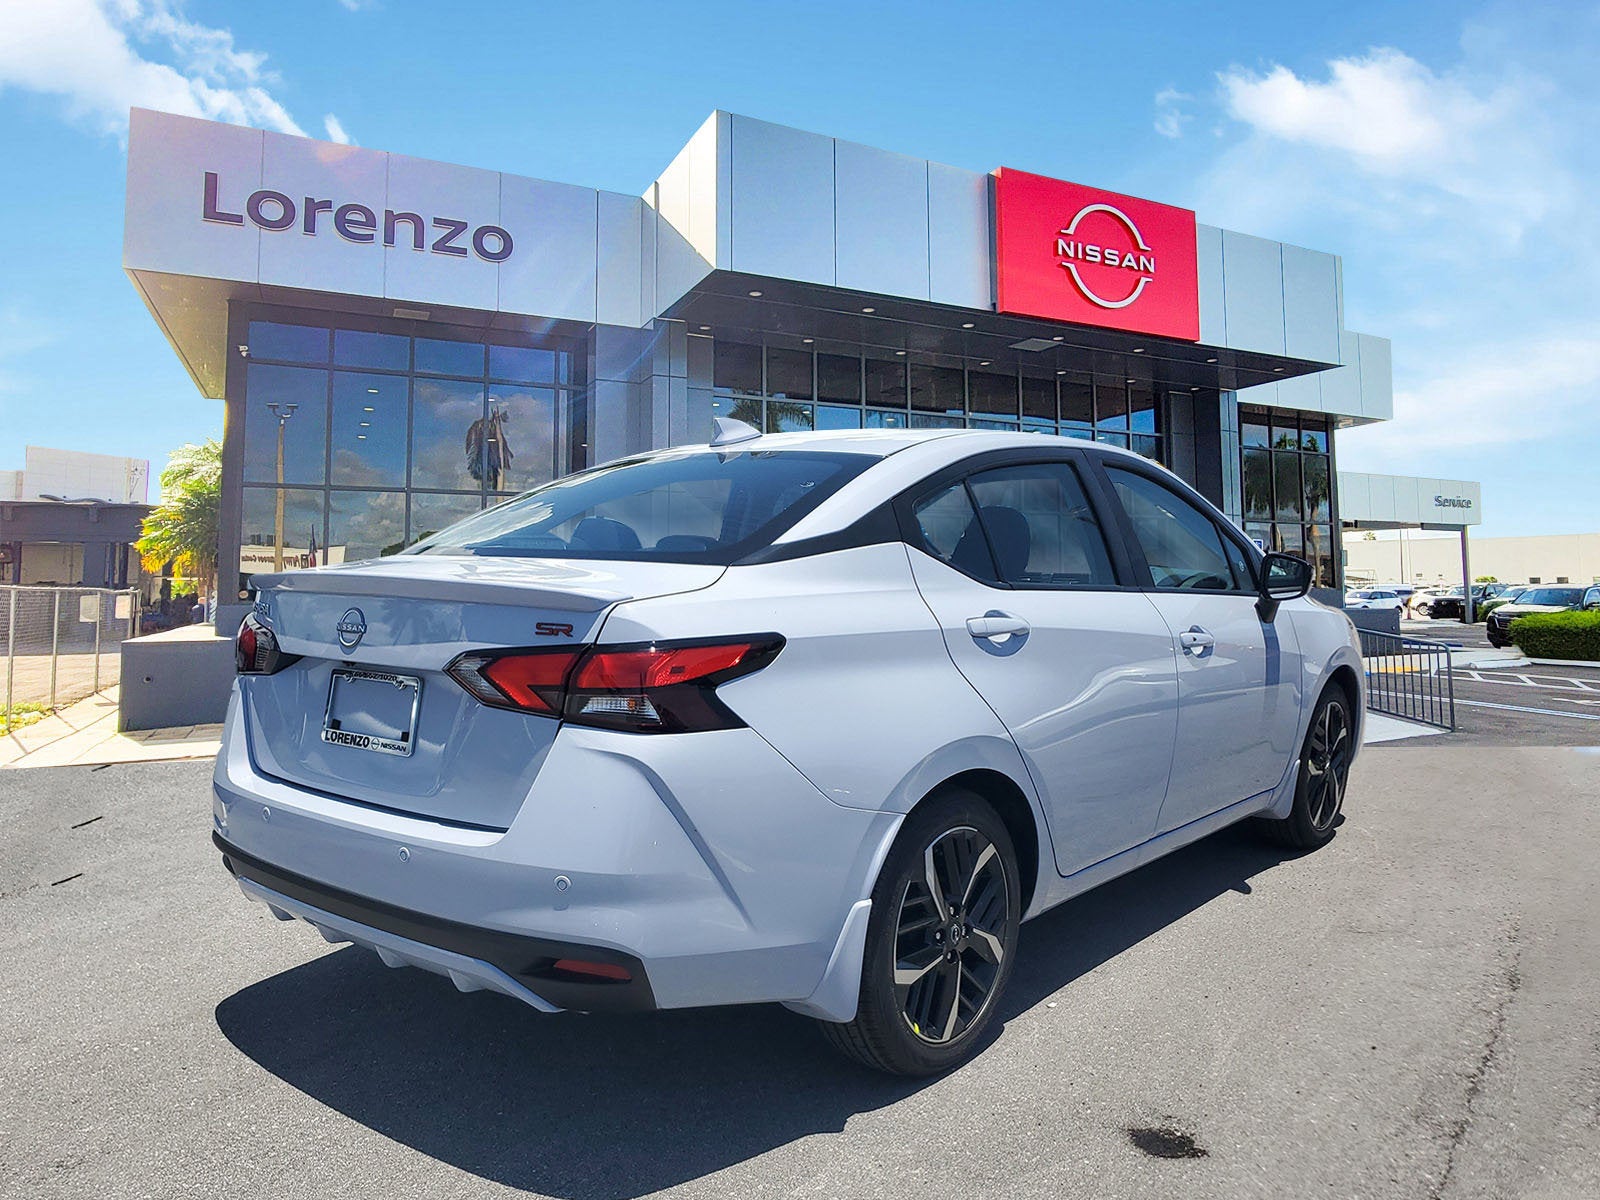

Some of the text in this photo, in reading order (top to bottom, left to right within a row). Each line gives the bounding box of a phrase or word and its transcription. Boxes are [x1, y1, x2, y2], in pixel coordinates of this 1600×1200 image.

[202, 171, 514, 262] Lorenzo
[1056, 238, 1155, 273] NISSAN
[1434, 495, 1472, 509] Service
[336, 622, 366, 633] SSAN
[535, 622, 574, 637] SR
[324, 729, 407, 753] LORENZO NISSAN
